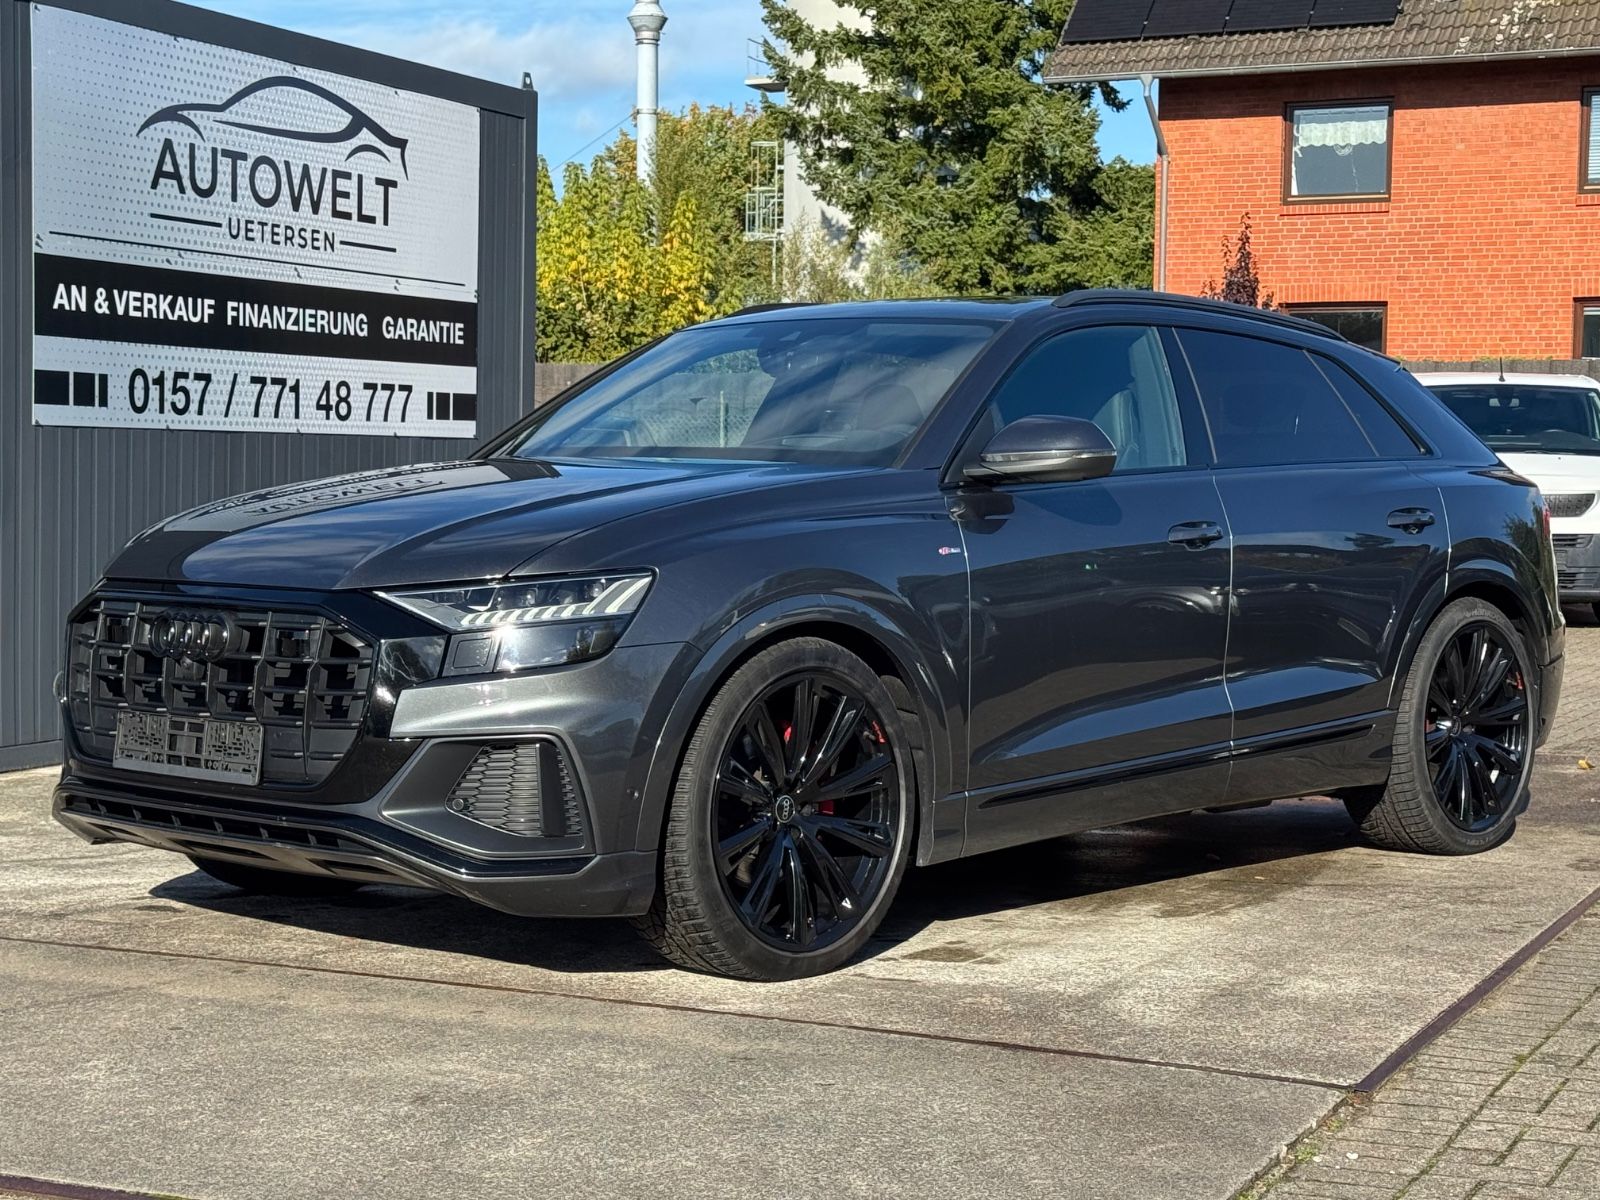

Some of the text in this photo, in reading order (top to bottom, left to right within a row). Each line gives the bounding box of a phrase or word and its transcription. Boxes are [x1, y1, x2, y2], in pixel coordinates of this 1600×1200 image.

[150, 137, 398, 227] AUTOWELT
[228, 216, 335, 253] UETERSEN
[52, 283, 87, 312] AN
[227, 301, 368, 337] FINANZIERUNG
[382, 315, 464, 345] GARANTIE
[128, 367, 413, 423] 0157 / 771 48 777
